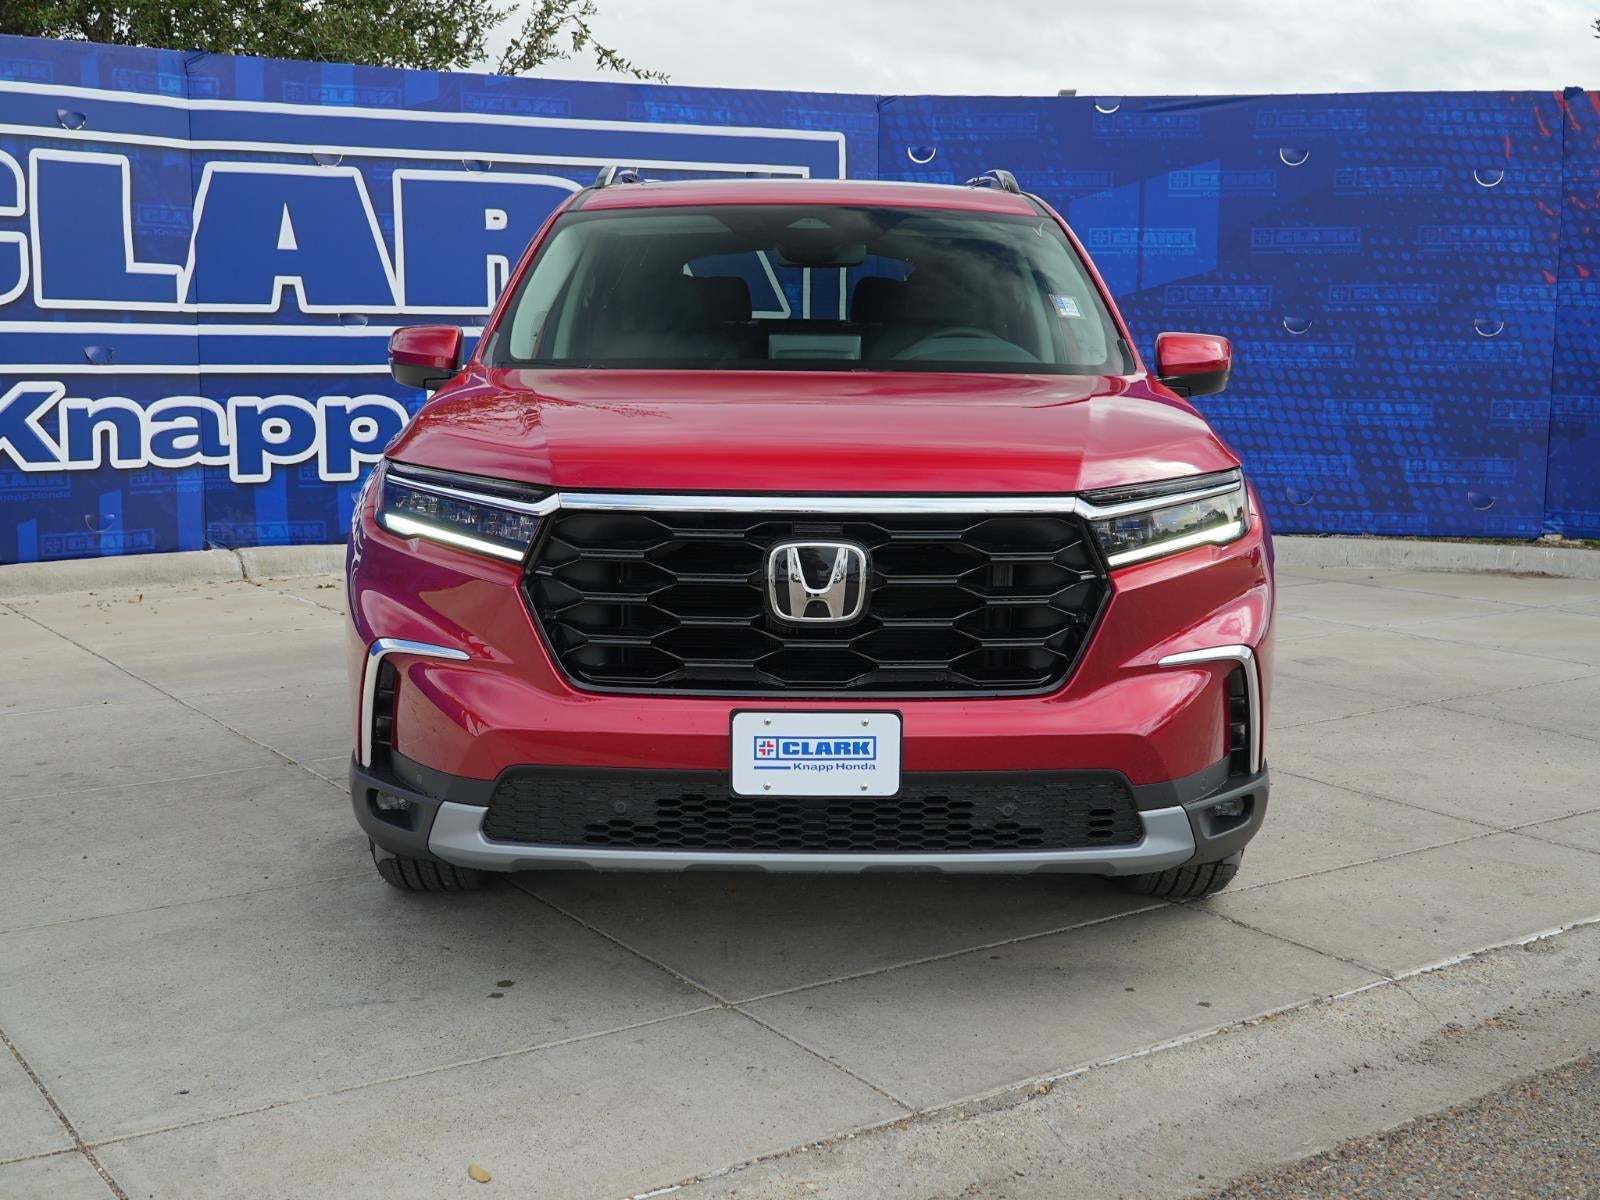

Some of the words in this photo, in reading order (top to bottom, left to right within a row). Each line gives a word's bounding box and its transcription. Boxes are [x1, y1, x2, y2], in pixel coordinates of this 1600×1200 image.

[0, 148, 584, 314] LAR
[0, 381, 411, 484] Knapp
[782, 741, 871, 756] CLARK
[793, 763, 834, 772] Knapp
[836, 763, 876, 771] Honda
